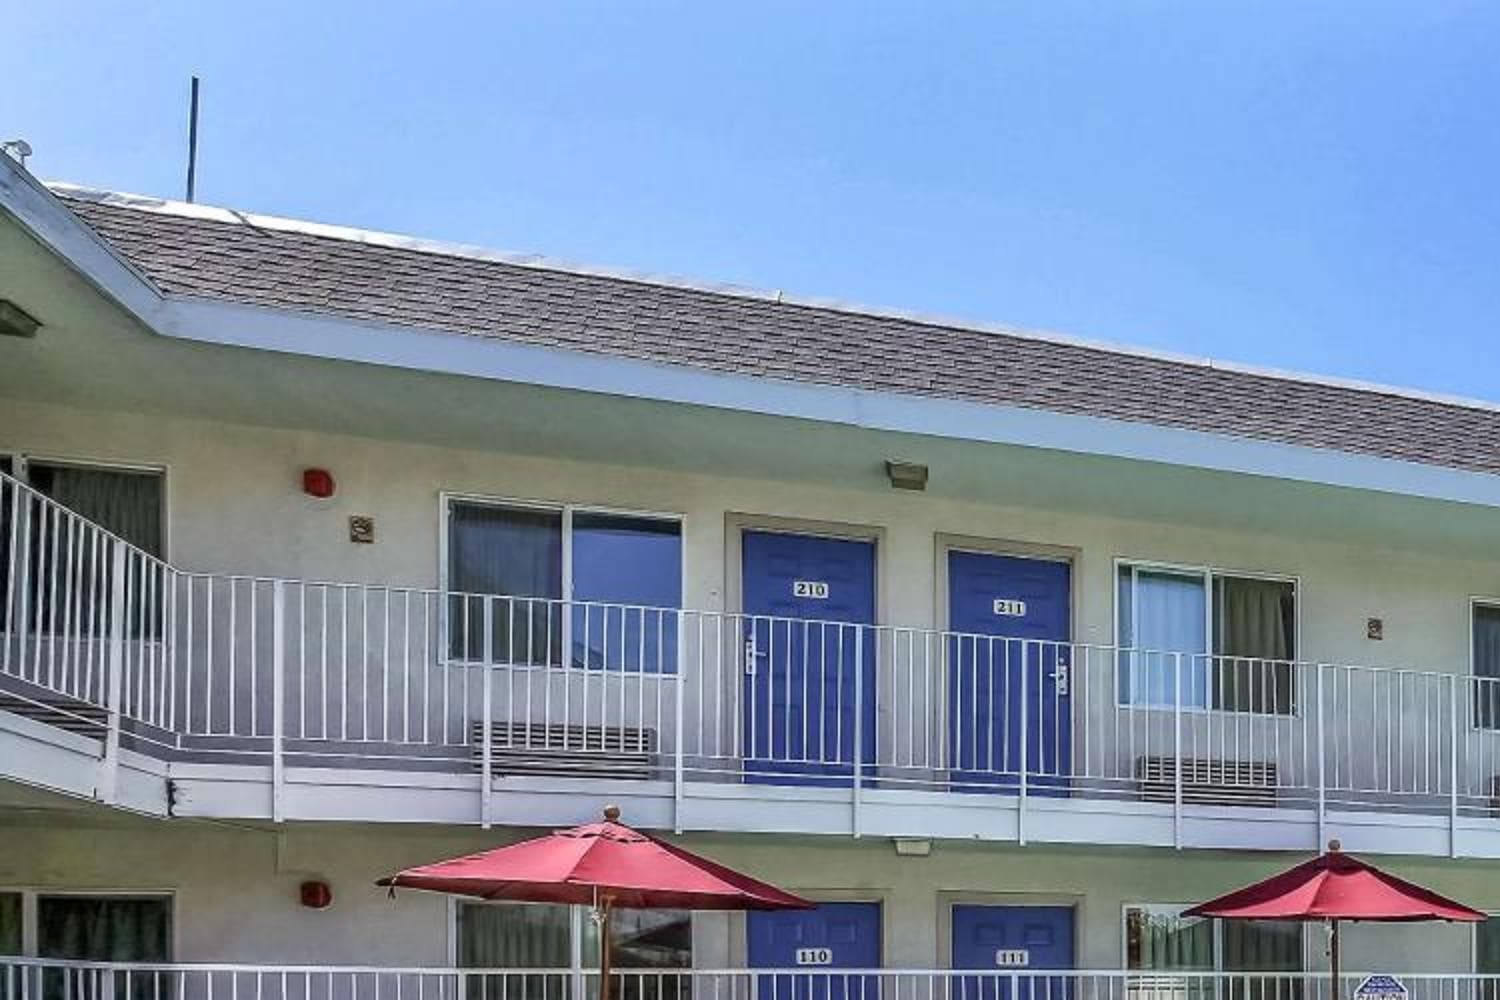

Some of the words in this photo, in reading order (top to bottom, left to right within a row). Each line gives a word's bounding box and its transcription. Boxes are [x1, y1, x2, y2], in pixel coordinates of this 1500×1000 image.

[797, 583, 825, 596] 210
[997, 601, 1023, 614] 211
[800, 951, 827, 962] 110
[1001, 953, 1025, 963] 111
